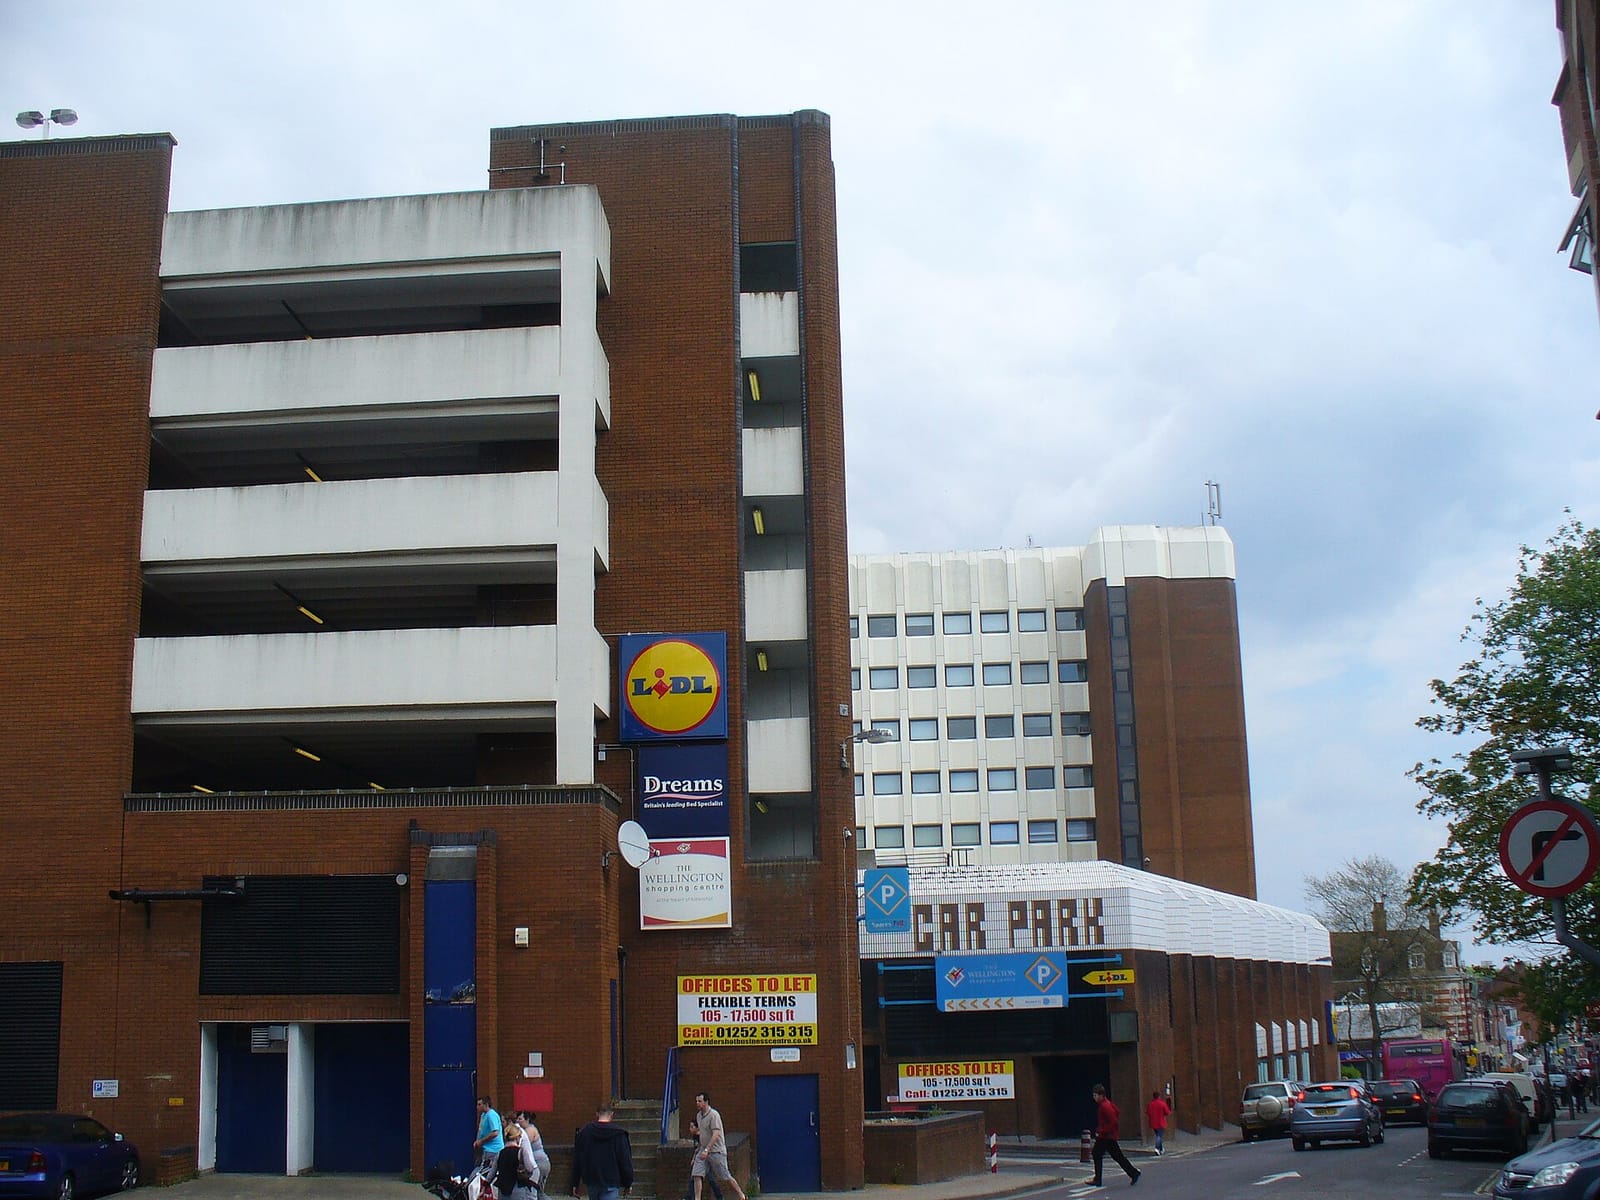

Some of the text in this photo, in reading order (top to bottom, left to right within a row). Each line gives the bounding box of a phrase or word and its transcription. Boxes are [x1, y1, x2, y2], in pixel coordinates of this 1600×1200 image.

[644, 776, 723, 793] Dreams
[645, 873, 724, 884] WELLINGTON
[646, 885, 690, 893] shopping
[881, 885, 895, 905] P
[913, 897, 1105, 952] CAR PARK
[967, 970, 1016, 978] WELLINGTON
[1037, 965, 1051, 985] P
[682, 977, 812, 992] OFFICES TO LET
[698, 995, 796, 1008] FLEXIBLE TERMS
[700, 1010, 721, 1022] 105
[731, 1009, 767, 1023] 17,500
[769, 1012, 783, 1022] sq
[785, 1009, 795, 1021] ft
[682, 1026, 813, 1038] Call: 01252 315 315
[906, 1062, 1006, 1077] OFFICES TO LET
[922, 1077, 938, 1088] 105
[943, 1077, 970, 1088] 17,500
[972, 1078, 983, 1087] sq
[984, 1076, 991, 1086] ft
[905, 1087, 1008, 1099] Call: 01252 315 315
